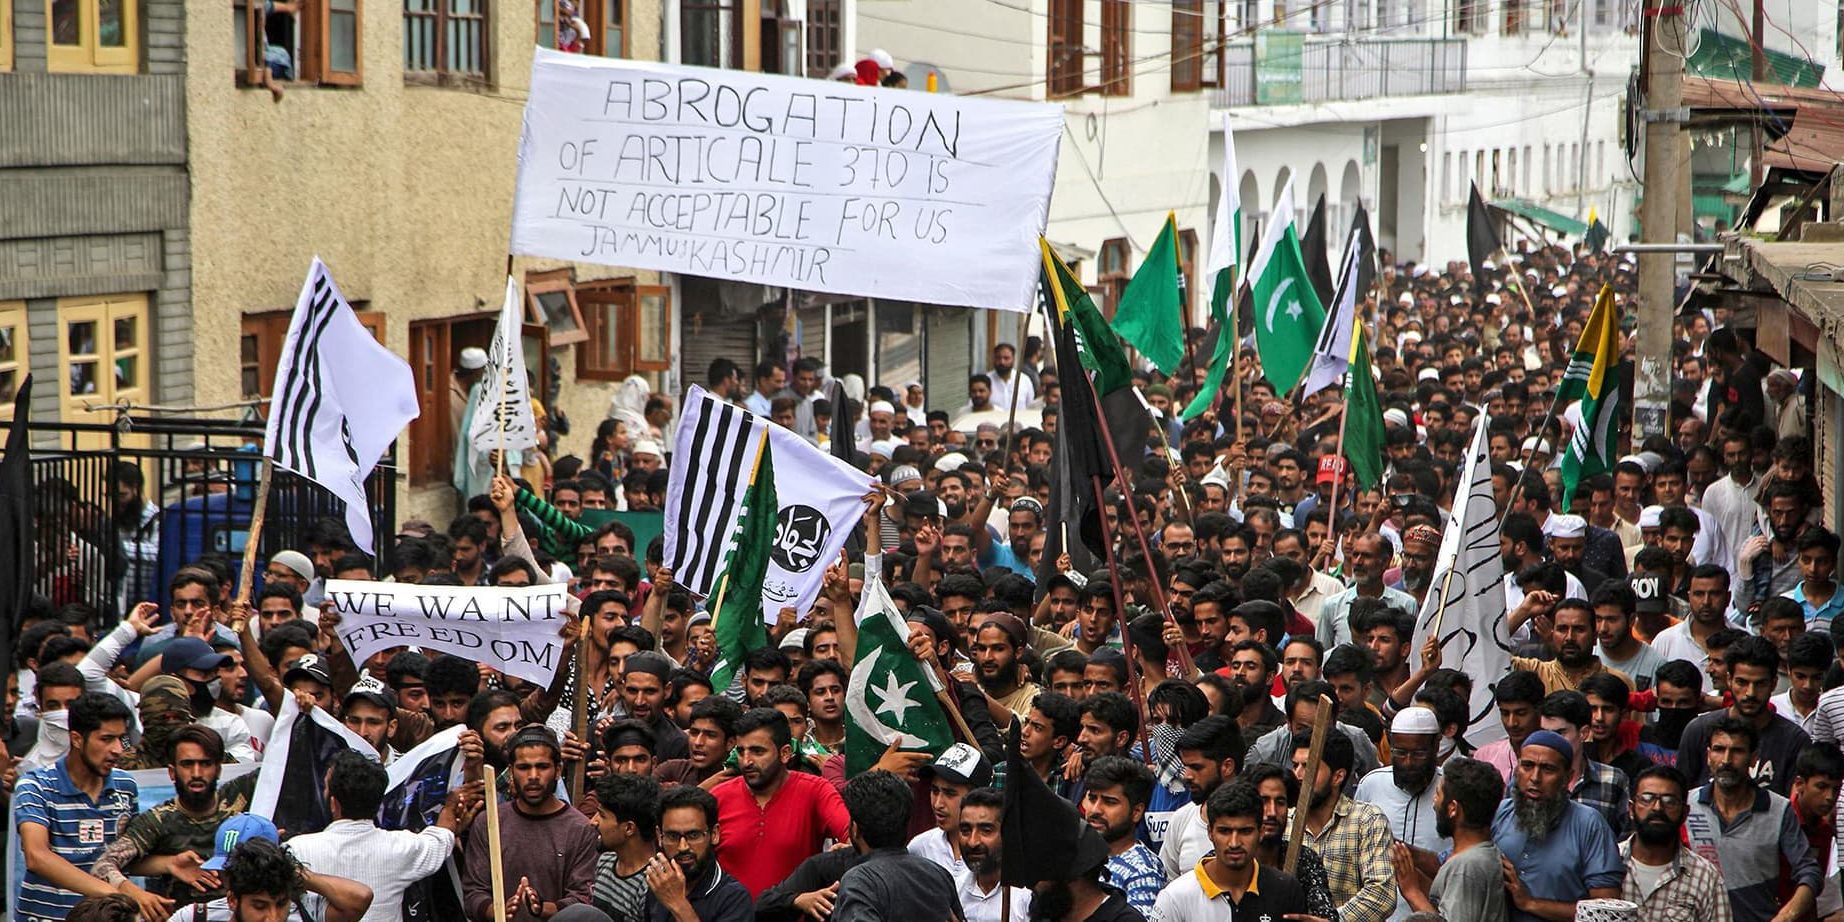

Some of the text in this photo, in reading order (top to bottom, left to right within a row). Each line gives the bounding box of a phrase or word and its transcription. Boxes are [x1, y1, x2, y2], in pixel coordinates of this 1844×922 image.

[559, 139, 598, 175] OF
[614, 134, 813, 188] ARTICALE
[840, 146, 908, 190] 370
[556, 186, 952, 245] NOT ACCEPTABLE FOR US
[328, 591, 561, 622] WE WANT
[342, 621, 555, 671] FREEDOM
[1147, 815, 1169, 839] Sup
